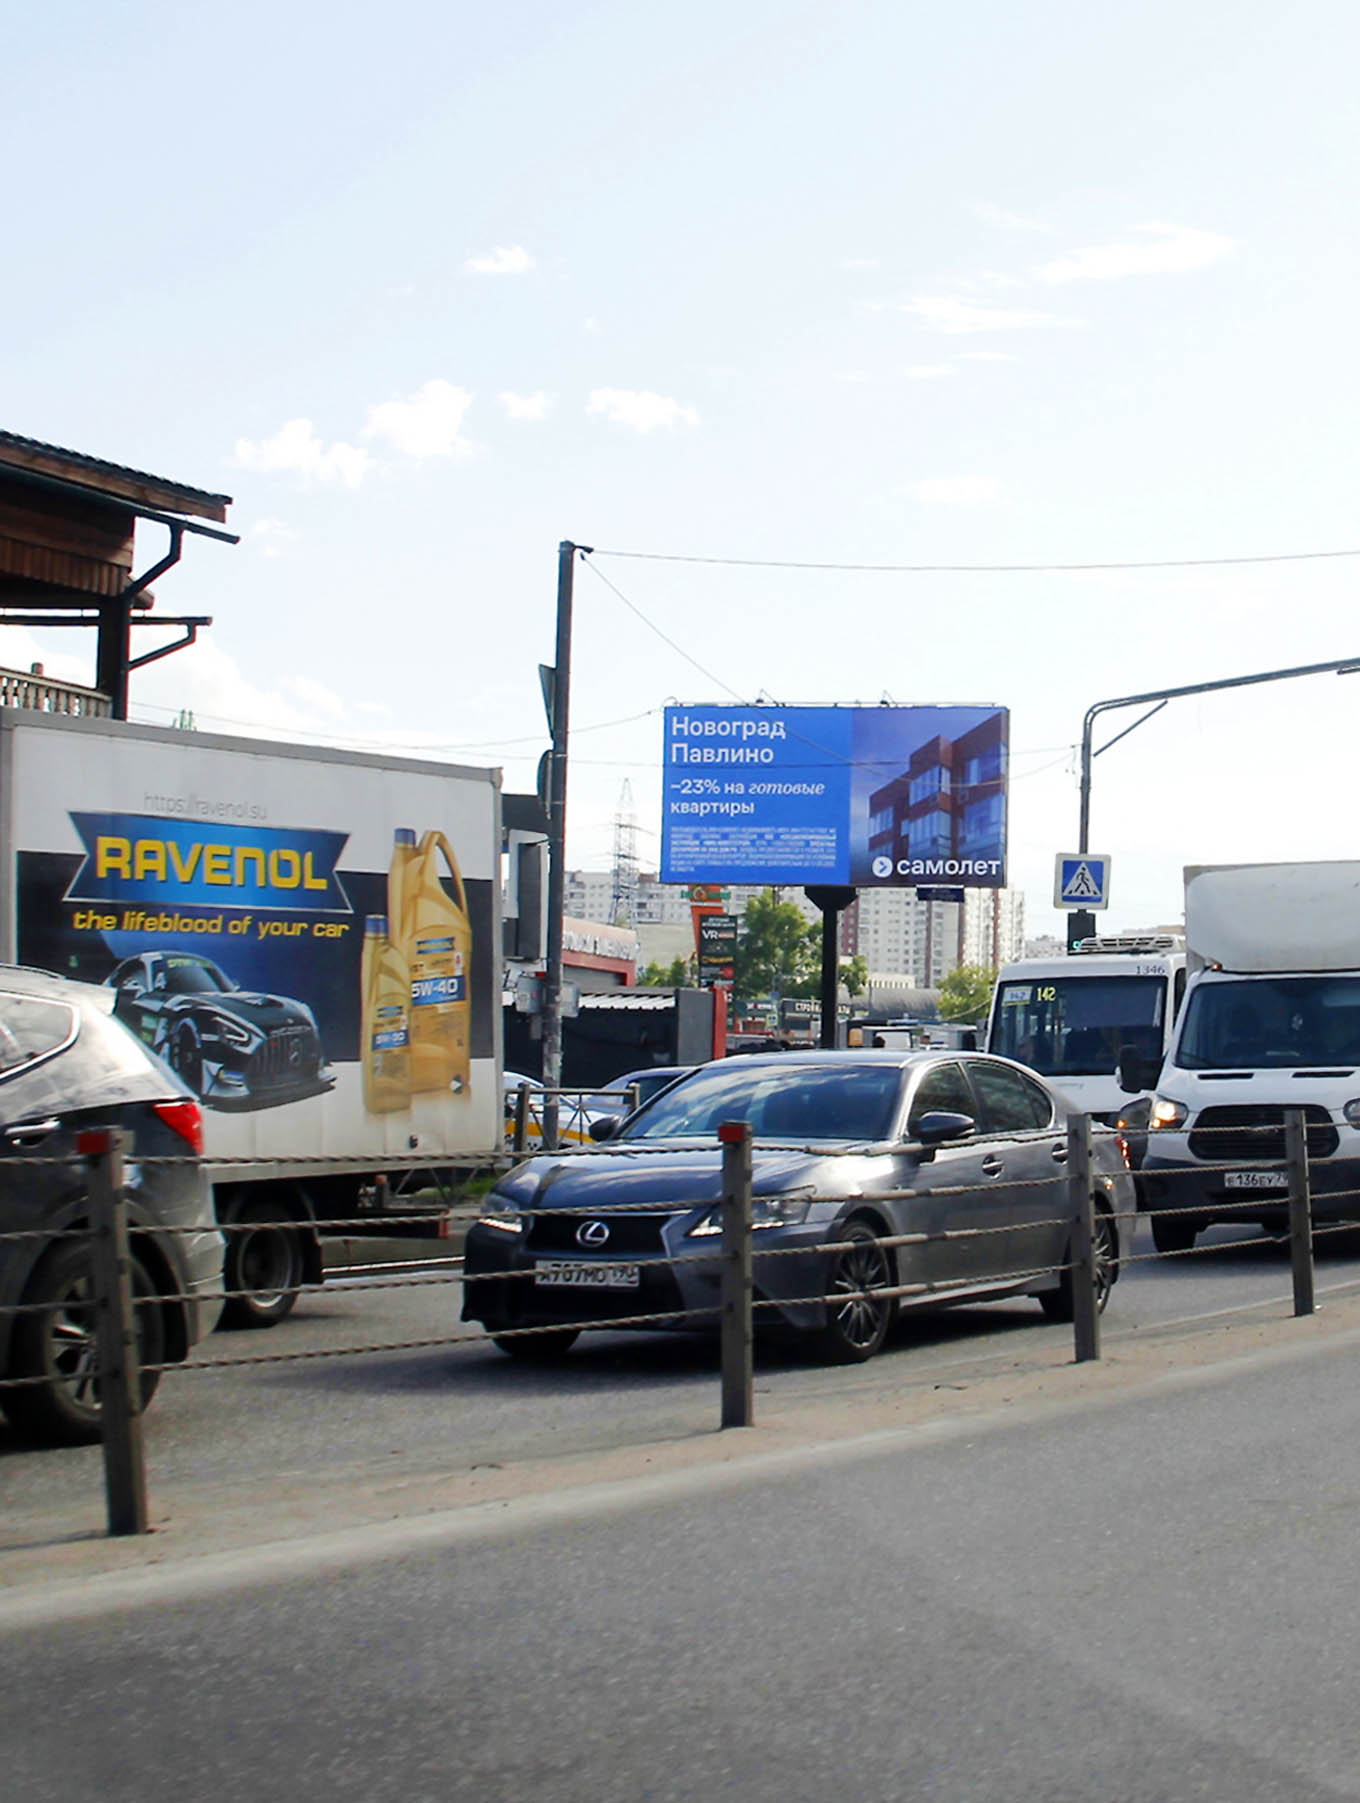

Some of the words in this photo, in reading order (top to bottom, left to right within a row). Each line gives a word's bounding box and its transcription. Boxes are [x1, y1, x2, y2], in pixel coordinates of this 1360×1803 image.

[671, 716, 786, 741] Новоград
[671, 743, 774, 763] Павлино
[724, 784, 745, 795] на
[748, 784, 825, 795] готовые
[670, 801, 755, 817] квартиры
[96, 836, 328, 890] RAVENOL
[896, 859, 1001, 875] самолет
[73, 910, 117, 931] the
[122, 911, 223, 933] lifeblood
[228, 916, 252, 935] of
[258, 921, 308, 940] your
[312, 922, 350, 938] car
[1136, 965, 1165, 975] 1346
[1036, 986, 1056, 1001] 142
